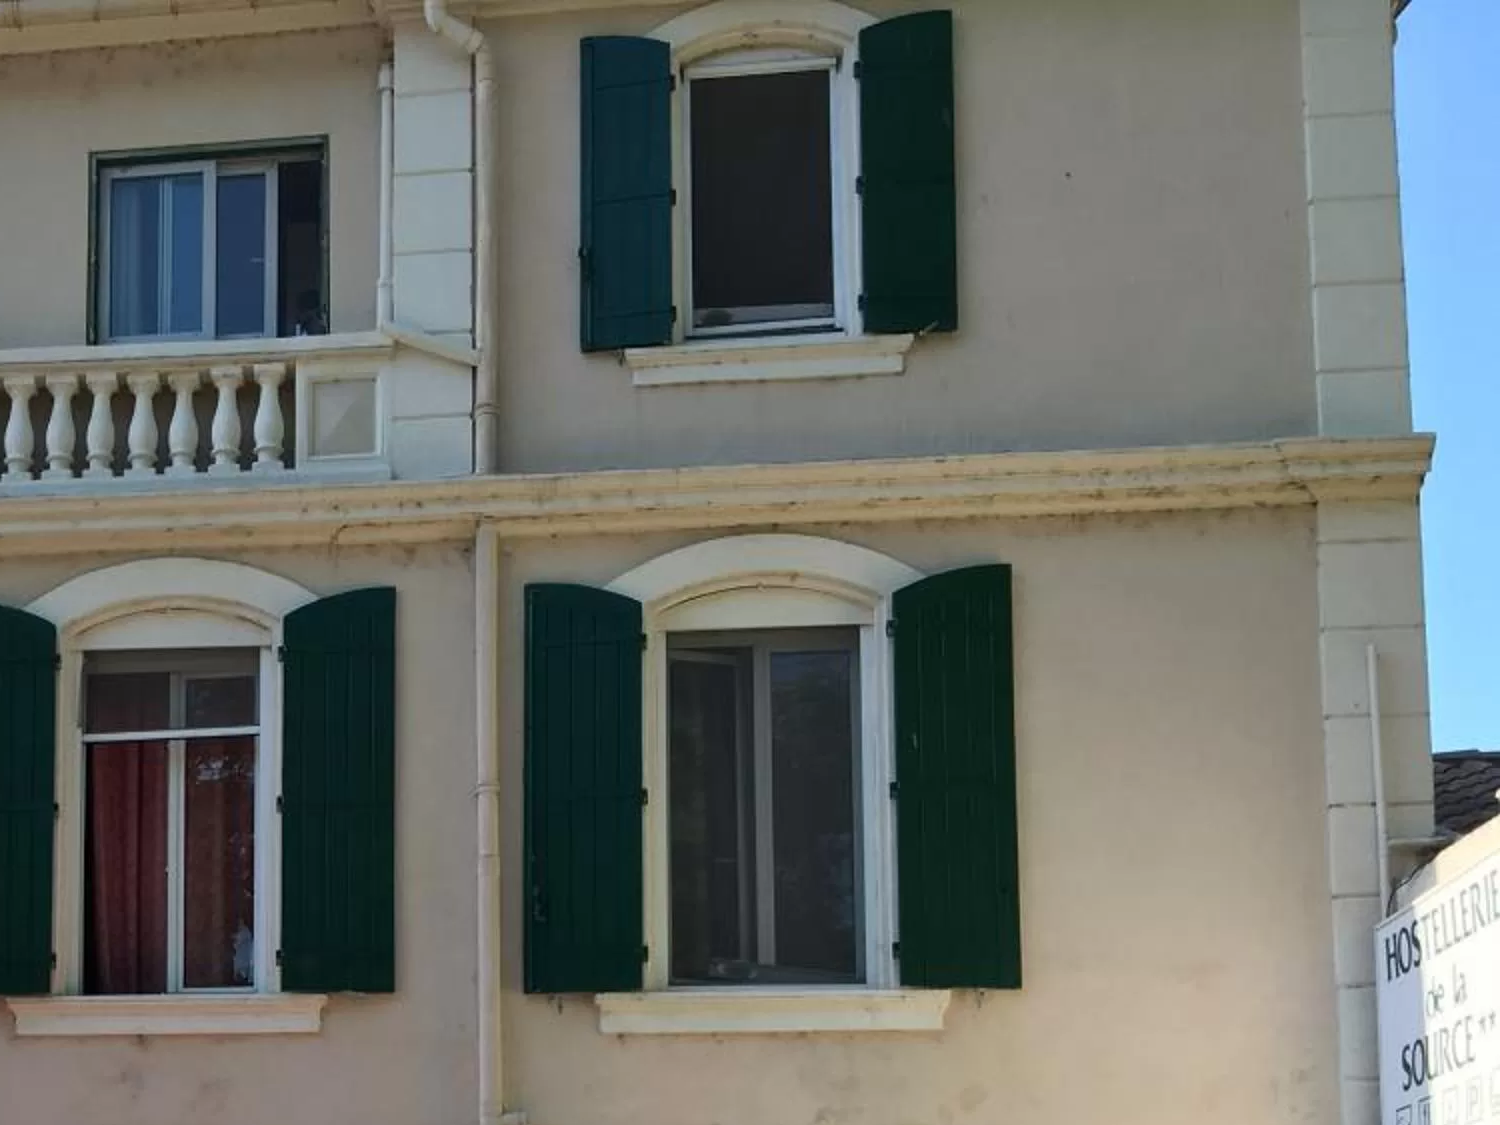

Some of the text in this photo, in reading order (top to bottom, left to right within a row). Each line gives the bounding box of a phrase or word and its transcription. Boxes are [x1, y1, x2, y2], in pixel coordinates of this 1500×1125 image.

[1385, 869, 1500, 982] HOSTELLERIE
[1425, 963, 1468, 1018] de la
[1401, 1015, 1476, 1092] SOURCE
